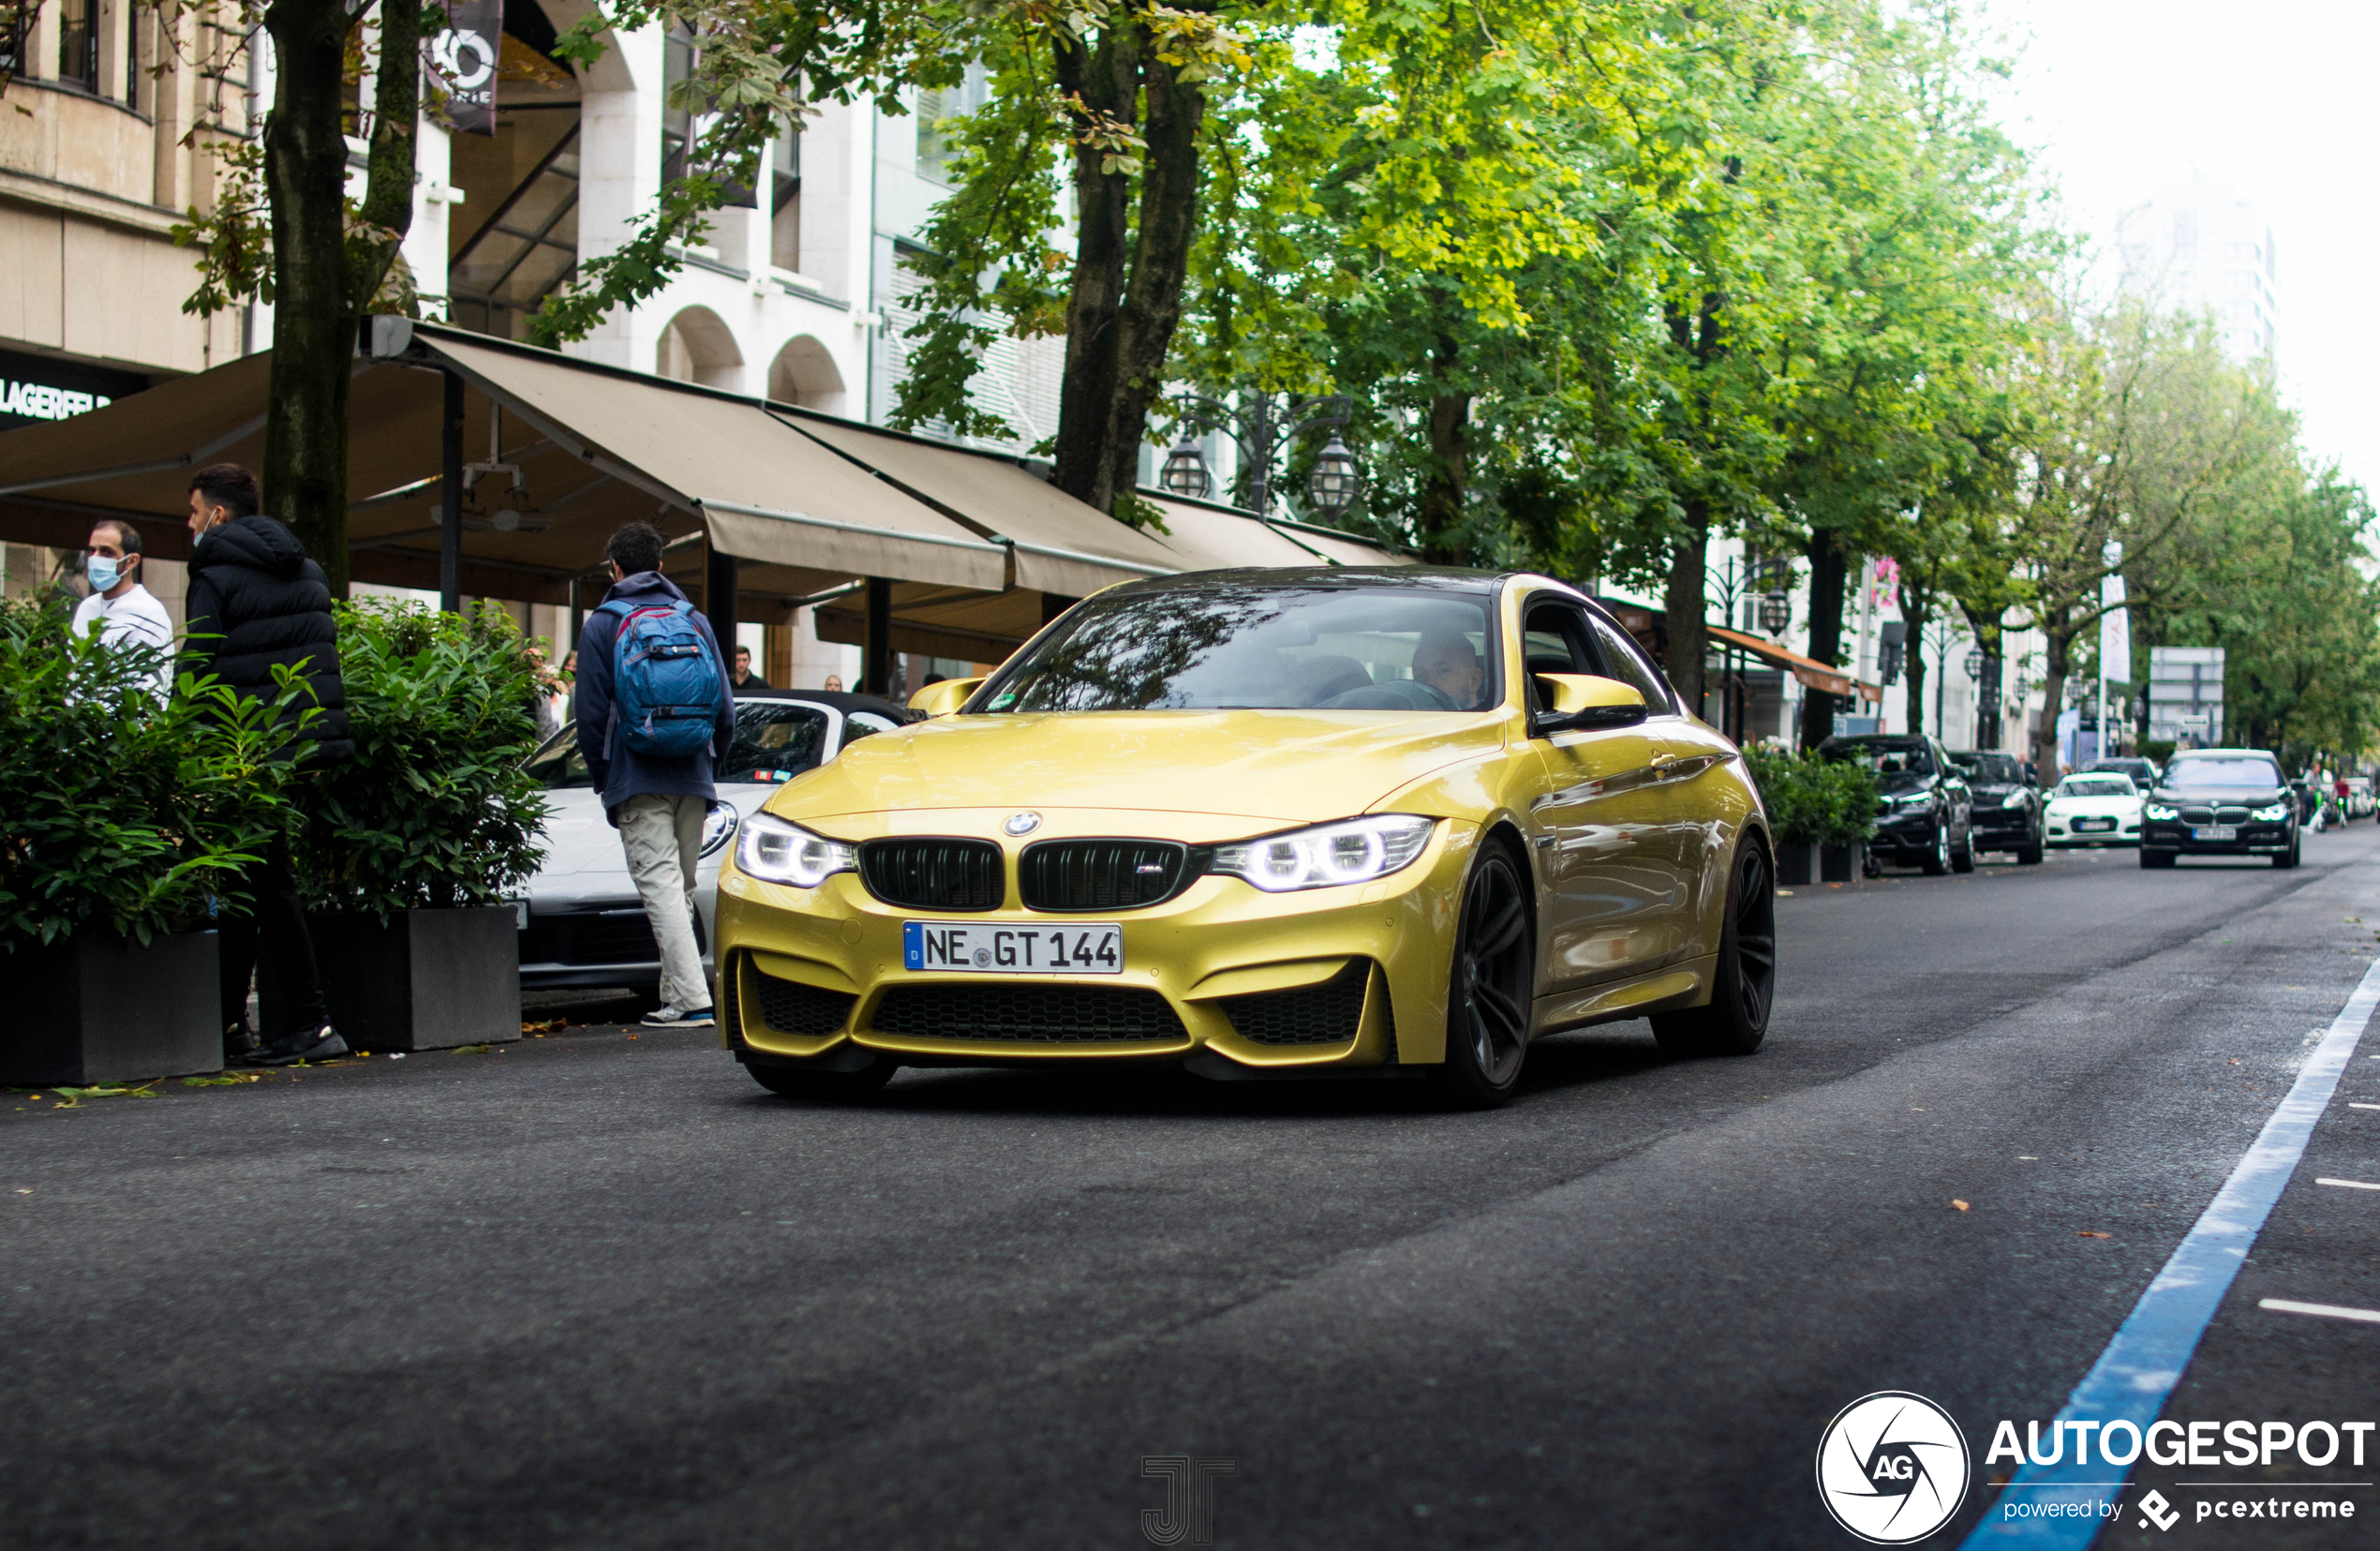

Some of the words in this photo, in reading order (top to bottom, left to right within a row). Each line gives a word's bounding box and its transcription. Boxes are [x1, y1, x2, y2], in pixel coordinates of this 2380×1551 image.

[926, 929, 970, 965] NE
[994, 931, 1040, 966] GT
[1049, 932, 1118, 967] 144
